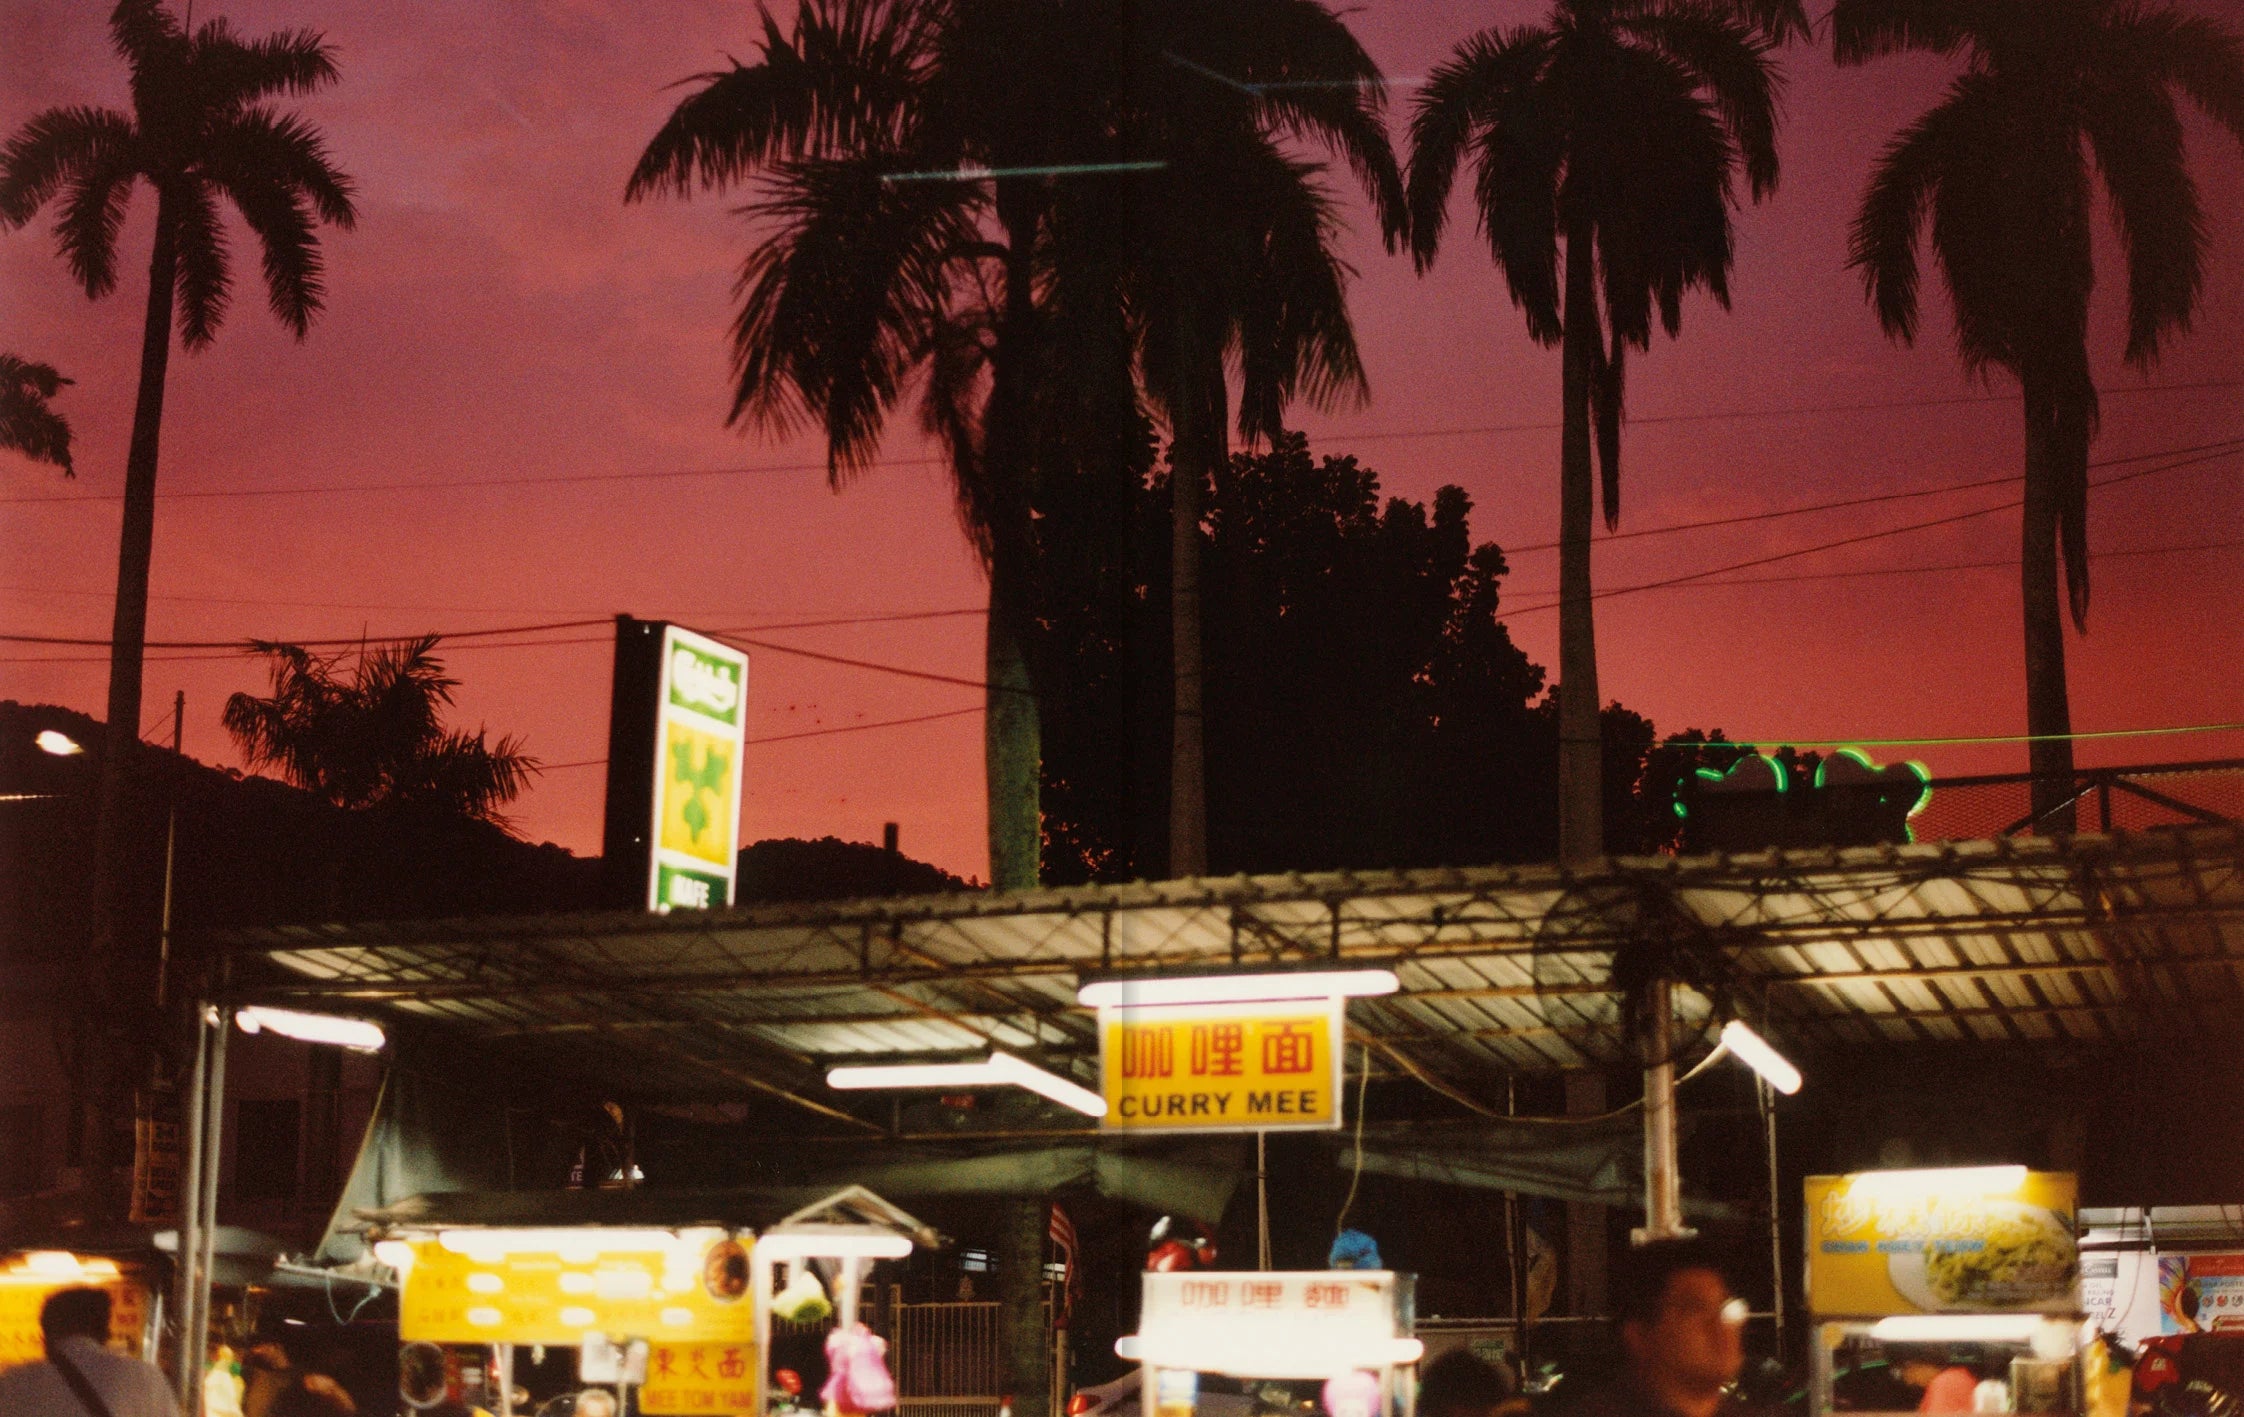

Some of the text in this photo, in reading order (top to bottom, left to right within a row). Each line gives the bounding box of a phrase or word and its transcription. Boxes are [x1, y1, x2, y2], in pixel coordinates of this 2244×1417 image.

[1121, 1022, 1313, 1078] 咖哩面
[1119, 1090, 1318, 1117] CURRY MEE
